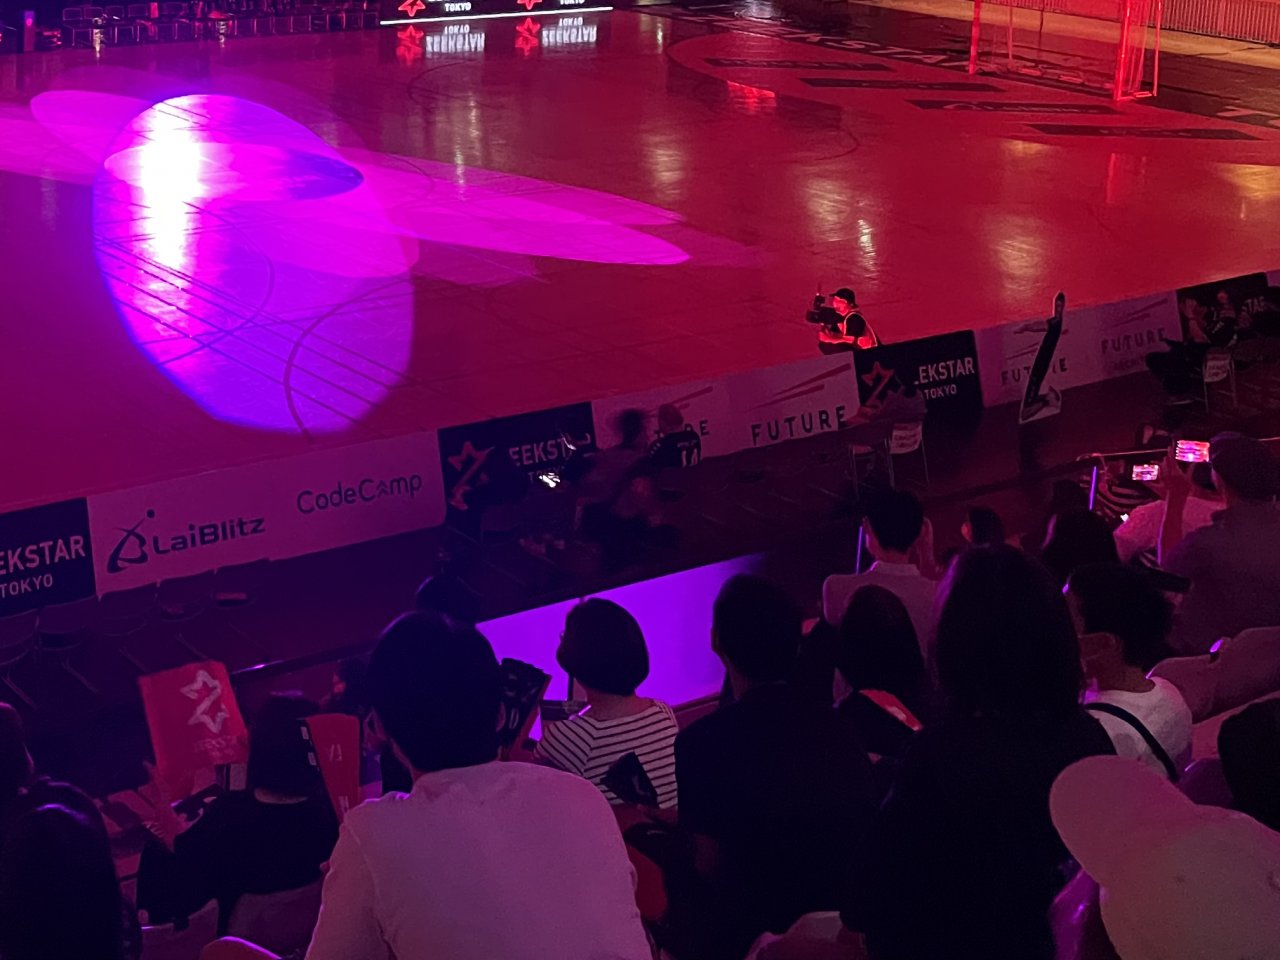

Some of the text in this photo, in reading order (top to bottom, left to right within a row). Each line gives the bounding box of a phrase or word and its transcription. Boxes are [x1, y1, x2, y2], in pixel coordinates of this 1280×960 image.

[444, 1, 472, 13] TOKYO
[914, 356, 976, 386] EKSTAR
[1001, 357, 1068, 386] FUTE
[923, 384, 958, 401] TOKYO
[751, 405, 846, 445] FUTURE
[152, 515, 266, 556] LaiBlitz
